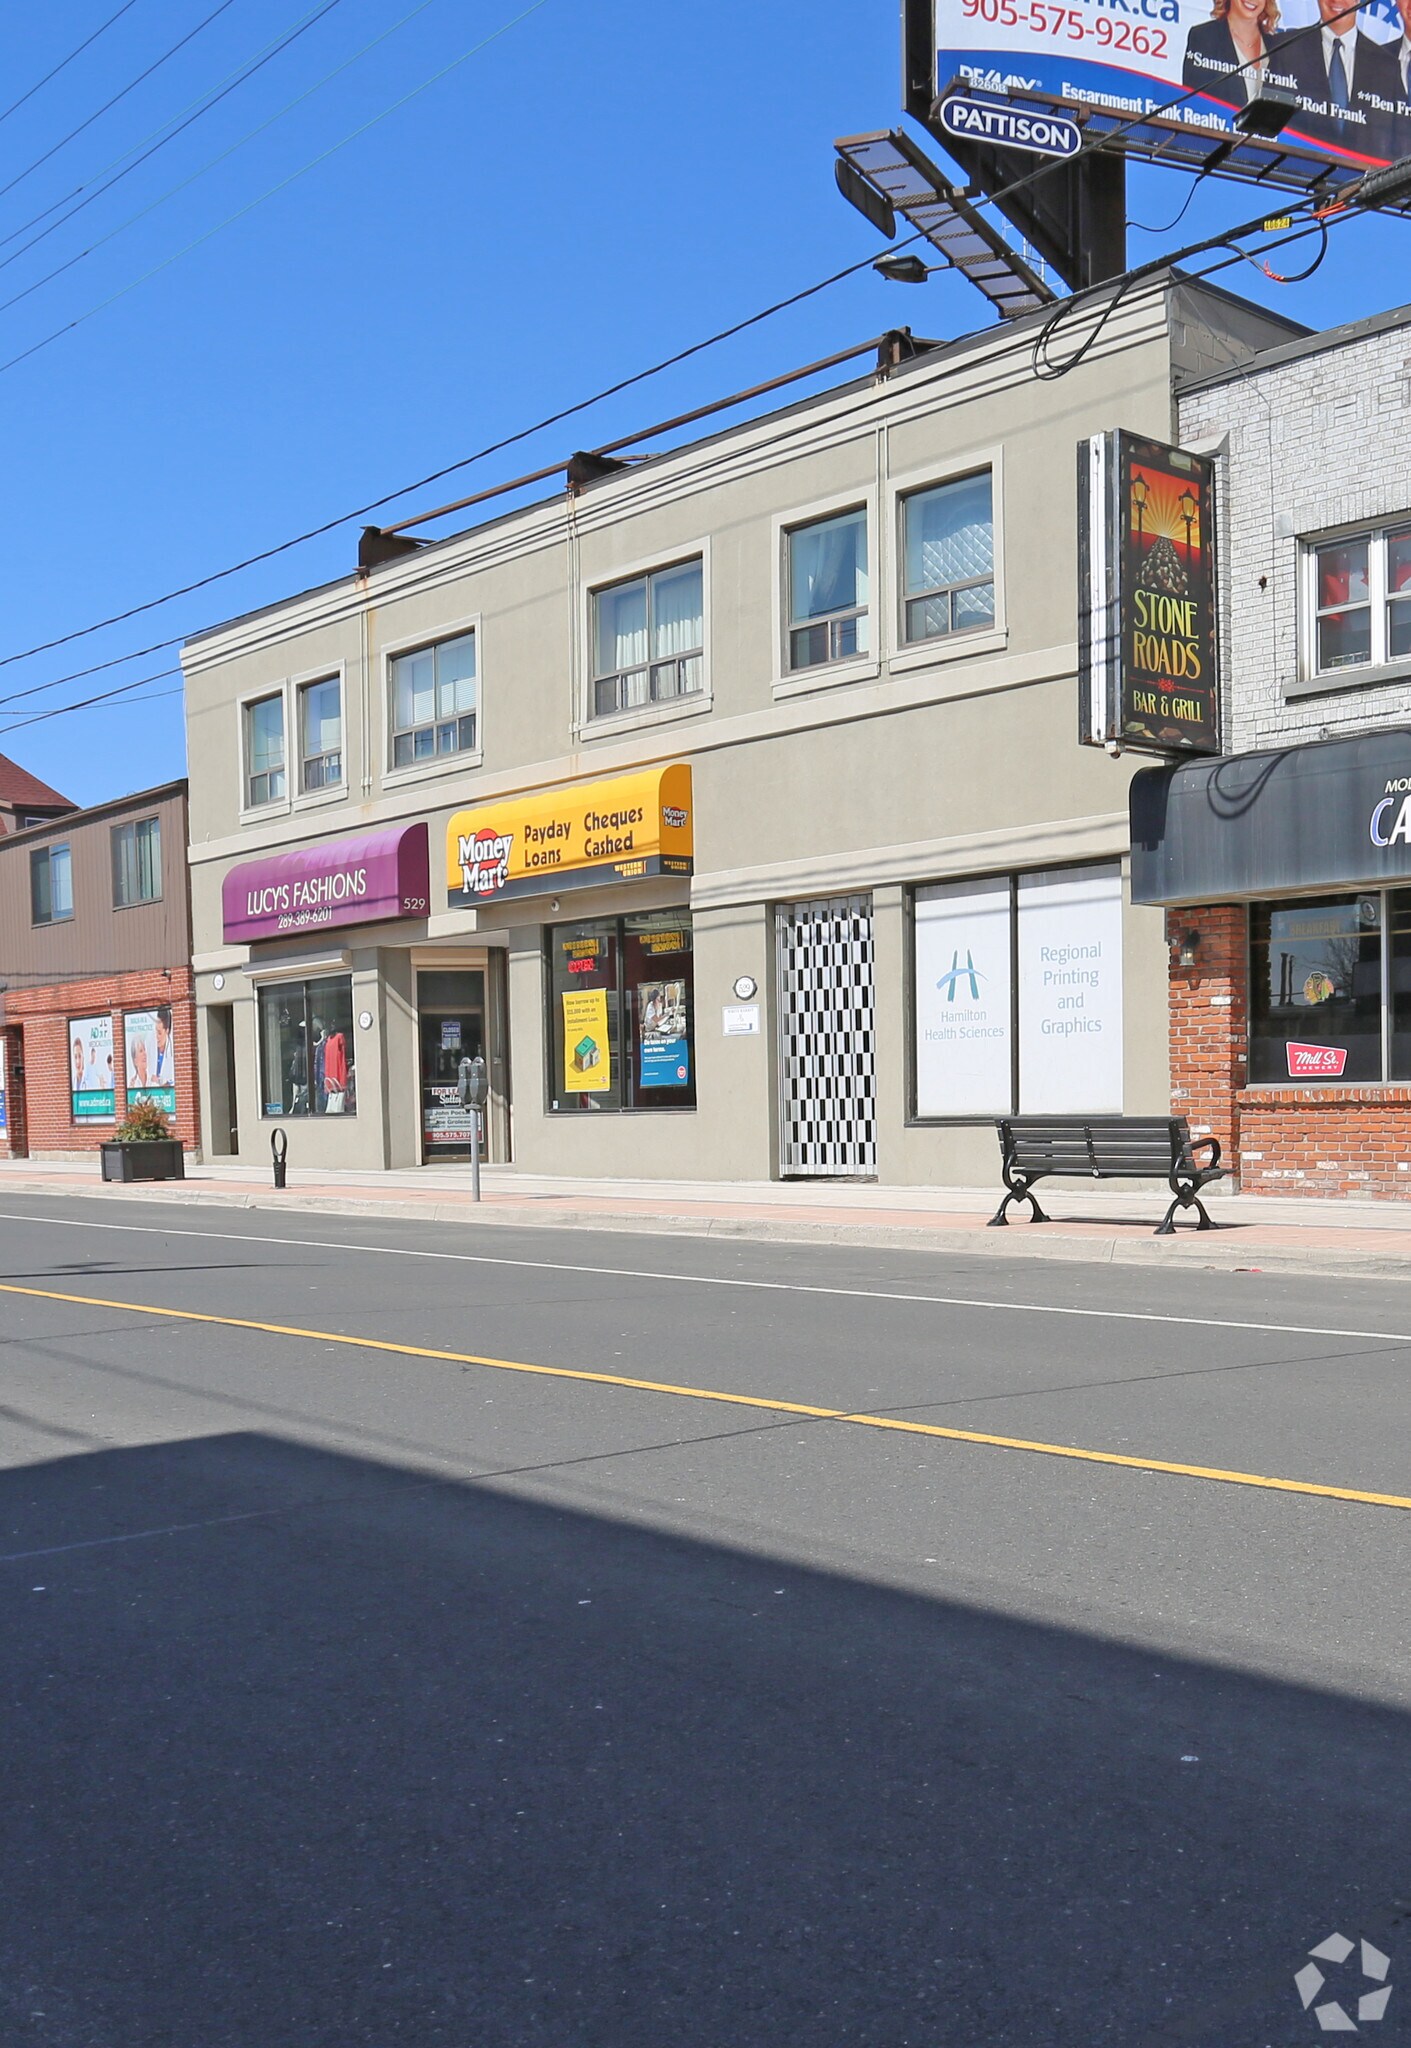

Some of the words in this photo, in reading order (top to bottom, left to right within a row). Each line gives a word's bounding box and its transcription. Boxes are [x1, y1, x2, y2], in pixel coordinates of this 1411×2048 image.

[961, 0, 1169, 59] 905-575-9262
[1262, 68, 1298, 89] Frank
[1330, 103, 1366, 124] Frank
[953, 104, 1070, 149] PATTISON
[1134, 589, 1200, 639] STONE
[1133, 630, 1201, 679] ROADS
[1133, 690, 1157, 714] BAR
[1160, 696, 1169, 716] &
[1172, 698, 1203, 722] GRILL
[584, 807, 643, 832] Cheques
[663, 806, 688, 818] Money
[524, 820, 571, 844] Payday
[584, 830, 633, 857] Cashed
[458, 833, 513, 865] Money
[524, 848, 561, 868] Loans
[462, 864, 505, 894] Mart
[247, 885, 290, 915] LUCY'S
[293, 868, 367, 907] FASHIONS
[404, 898, 426, 910] 529
[277, 905, 332, 929] 289-389-6201
[1040, 941, 1102, 965] Regional
[567, 958, 595, 973] OPEN
[1043, 968, 1099, 988] Printing
[1057, 992, 1084, 1010] and
[941, 1009, 987, 1022] Hamilton
[1041, 1016, 1102, 1038] Graphics
[925, 1028, 957, 1041] Health
[959, 1026, 1005, 1039] Sciences
[1294, 1051, 1322, 1065] Mill
[1323, 1051, 1339, 1065] St.
